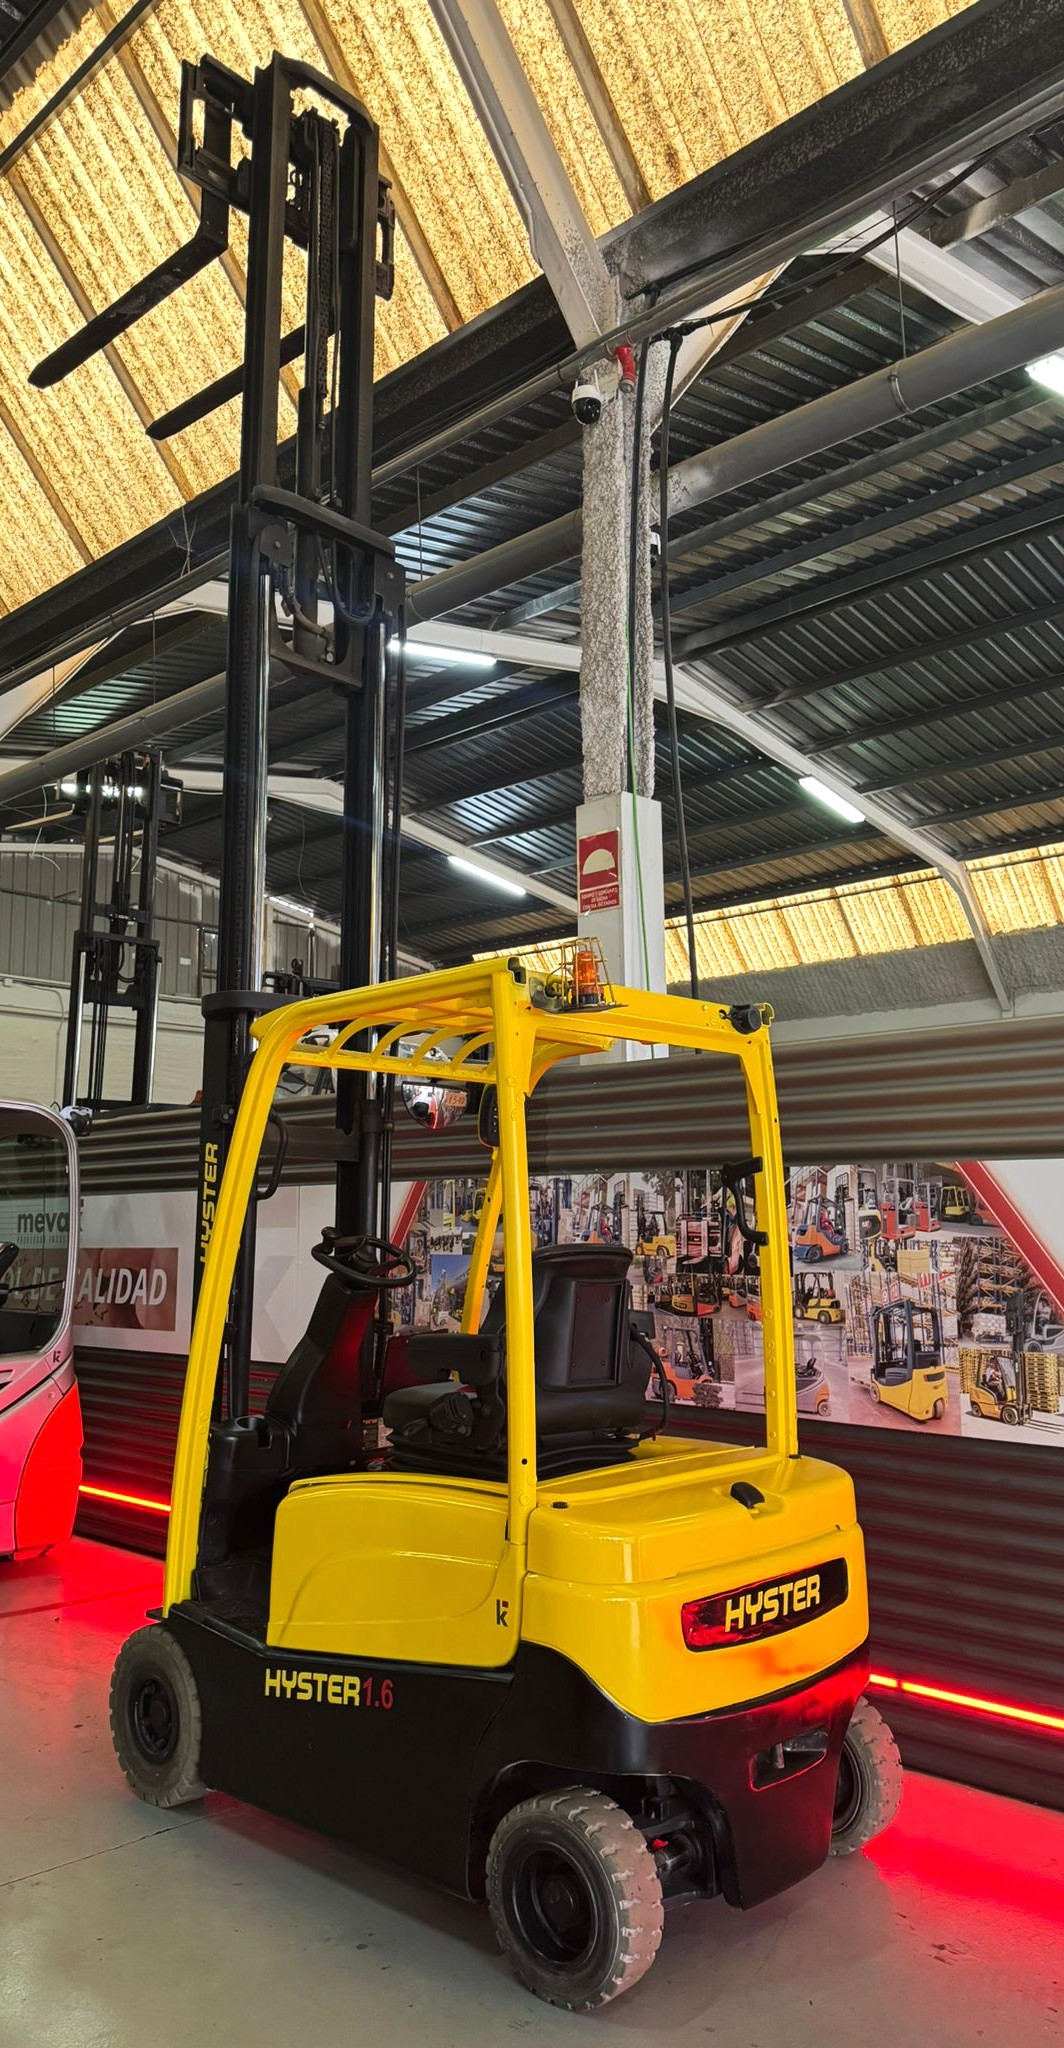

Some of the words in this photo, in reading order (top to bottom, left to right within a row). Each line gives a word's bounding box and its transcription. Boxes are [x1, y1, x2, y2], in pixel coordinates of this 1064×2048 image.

[17, 1210, 83, 1233] meva
[77, 1267, 168, 1306] ALIDAD
[725, 1574, 821, 1632] HYSTER
[264, 1668, 361, 1706] HYSTER
[363, 1676, 394, 1710] 1.6
